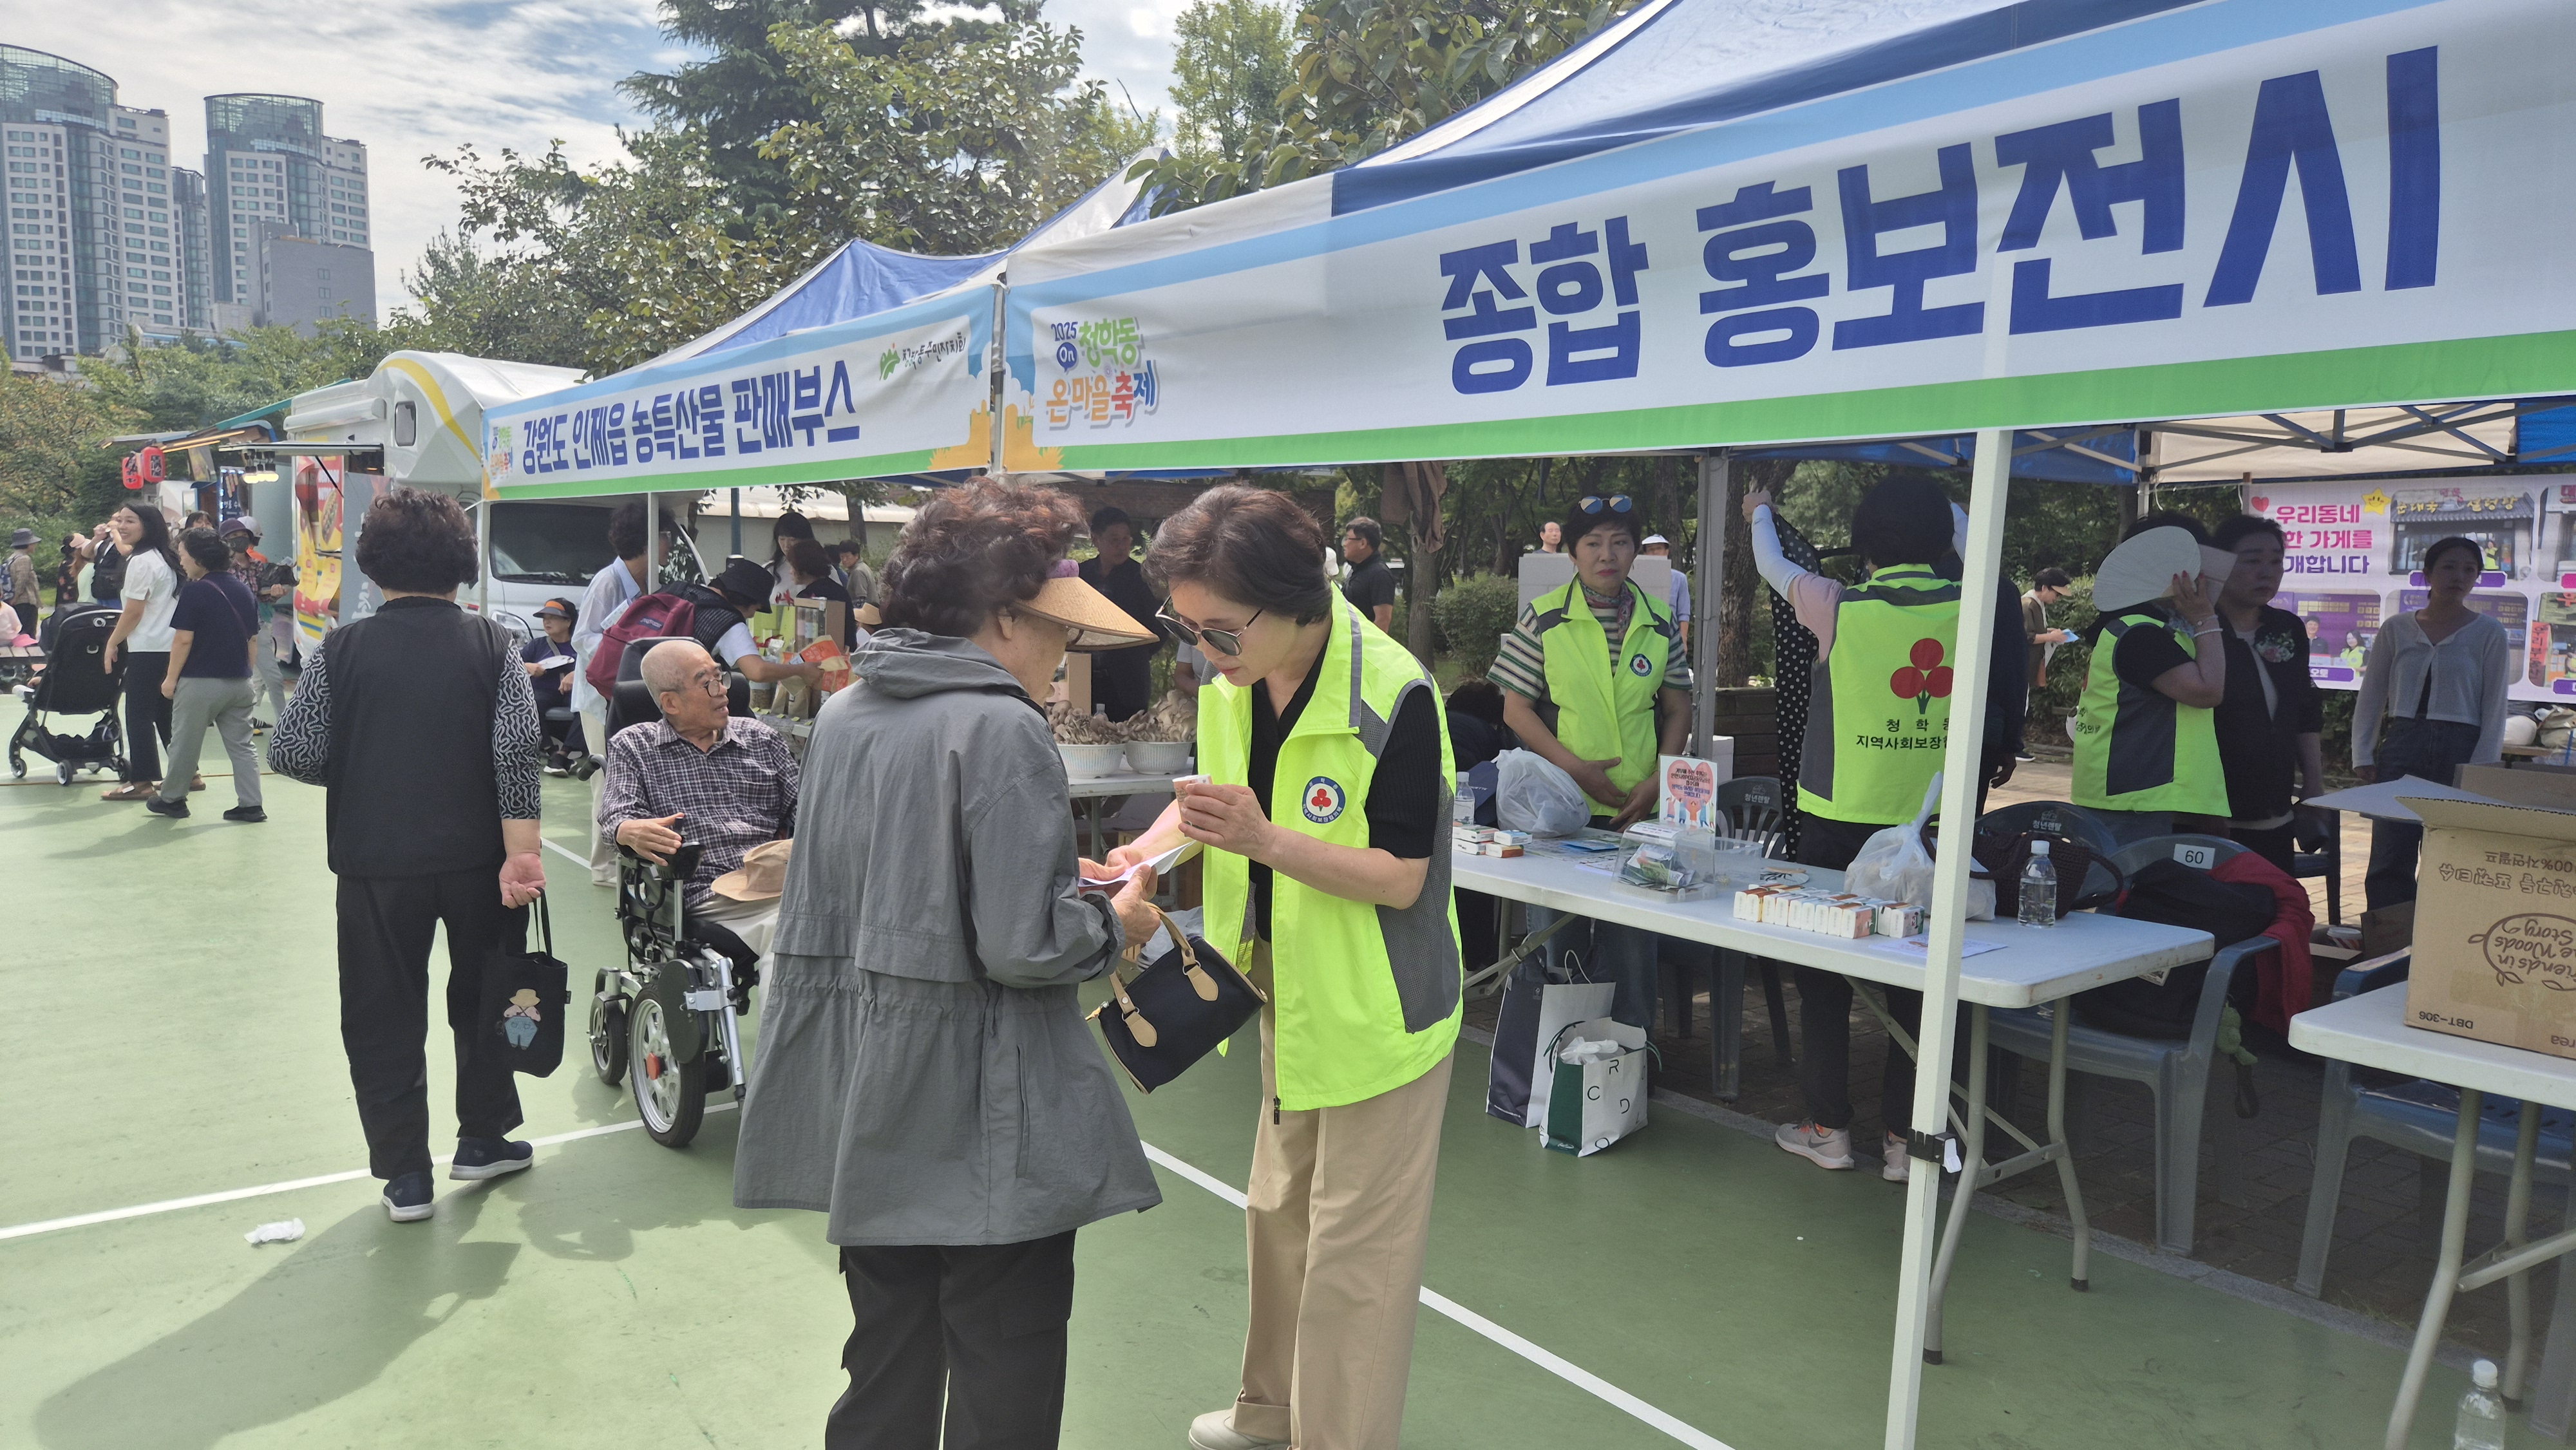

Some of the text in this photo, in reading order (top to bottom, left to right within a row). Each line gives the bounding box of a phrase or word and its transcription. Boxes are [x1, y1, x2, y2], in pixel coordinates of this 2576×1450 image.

[1439, 45, 2439, 395] 종합 홍보전시
[1051, 321, 1078, 341] 2025
[902, 332, 966, 370] 청학동주민자치회
[1079, 317, 1139, 368] 청학동
[1059, 346, 1075, 362] On
[1046, 360, 1155, 423] 온마을축제
[523, 360, 861, 475] 강원도 인제읍 농특산물 판매부스
[2467, 495, 2518, 512] 설렁탕
[2276, 504, 2360, 524] 우리동네
[2284, 529, 2373, 549] 한 가게를
[2284, 554, 2370, 574] 개합니다
[1856, 735, 1948, 749] 지역사회보장
[2032, 819, 2062, 832] 청년렌탈
[2184, 850, 2204, 865] 60
[2485, 851, 2574, 873] 00%자연펄프
[2439, 863, 2576, 899] 친구들 포켓티슈
[2524, 919, 2573, 946] Story
[2494, 936, 2557, 959] Woods
[2497, 954, 2576, 983] riends in
[2418, 1010, 2474, 1030] DBT-306
[2550, 1035, 2576, 1048] rea
[1609, 1059, 1619, 1075] R
[1587, 1086, 1600, 1100] C
